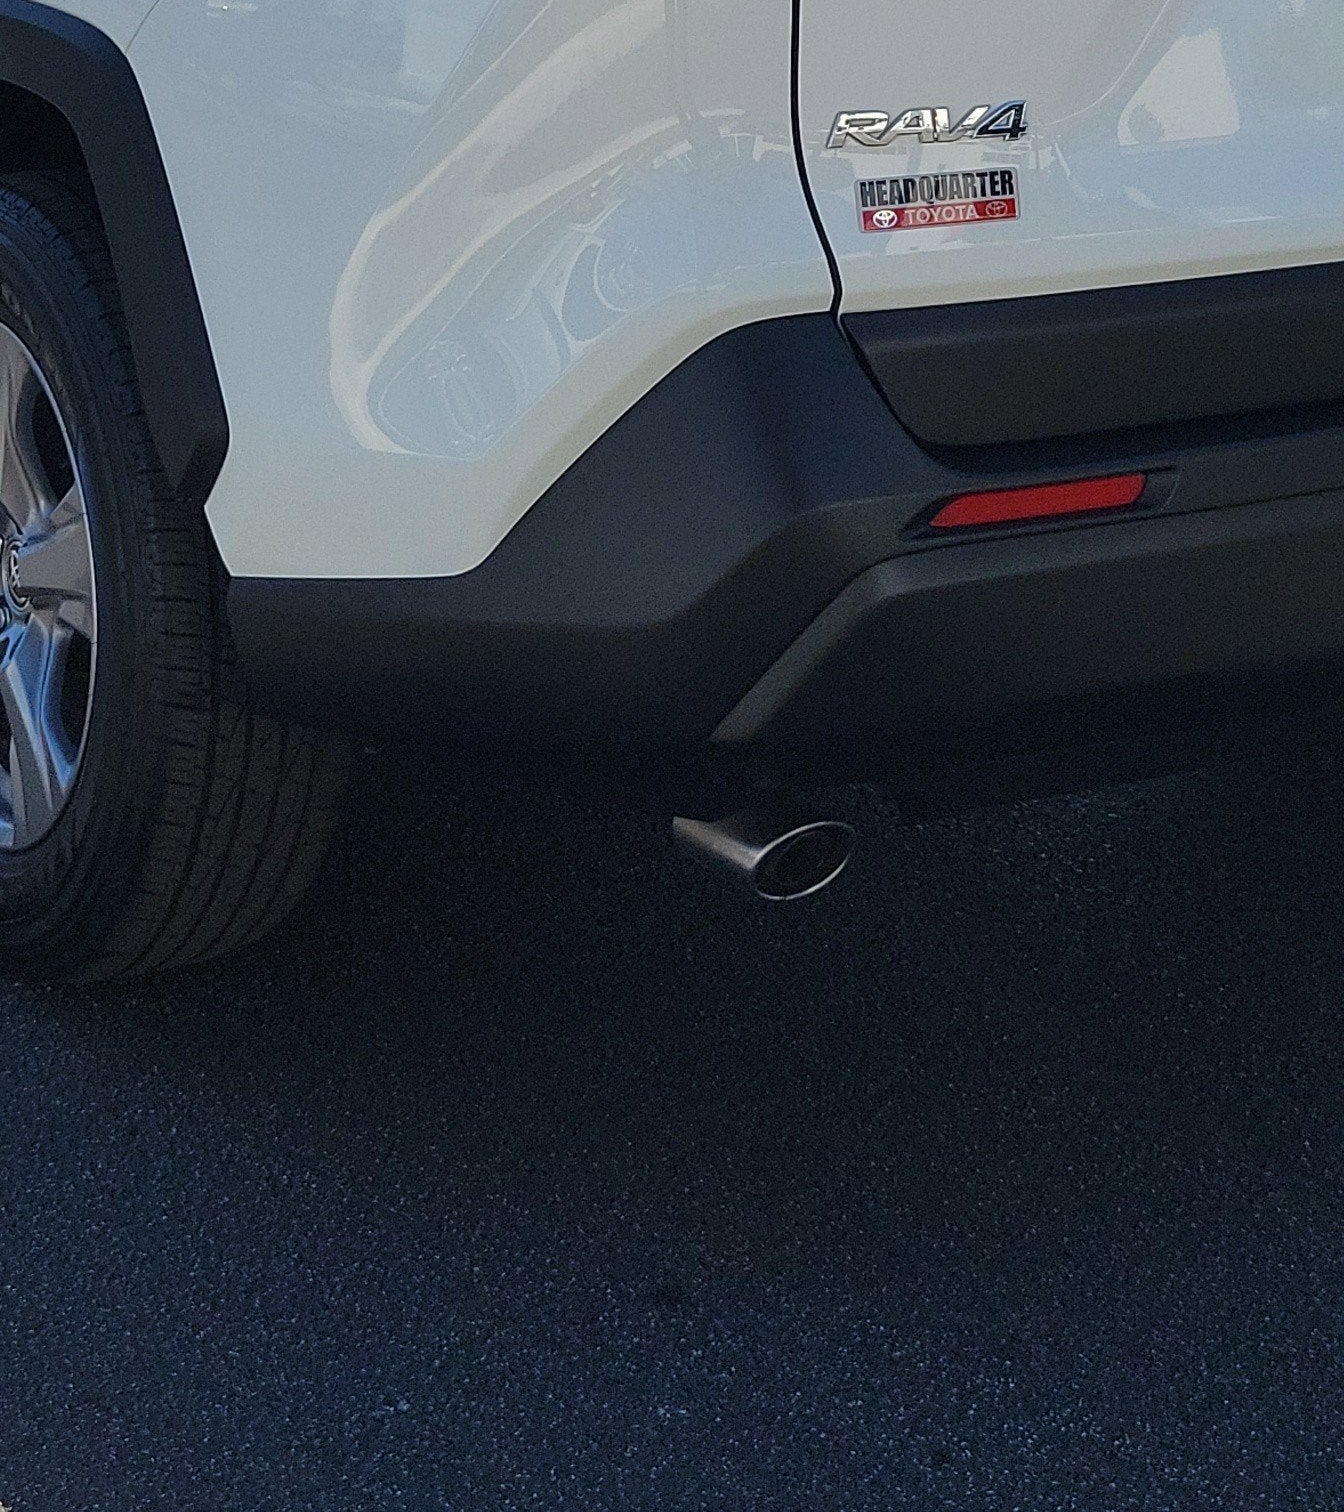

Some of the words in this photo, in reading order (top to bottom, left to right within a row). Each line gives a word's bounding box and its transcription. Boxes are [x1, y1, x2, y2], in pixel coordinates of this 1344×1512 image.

[826, 99, 1028, 149] RAV4
[859, 169, 1015, 208] HEADQUARTER
[905, 204, 980, 226] TOYOTA
